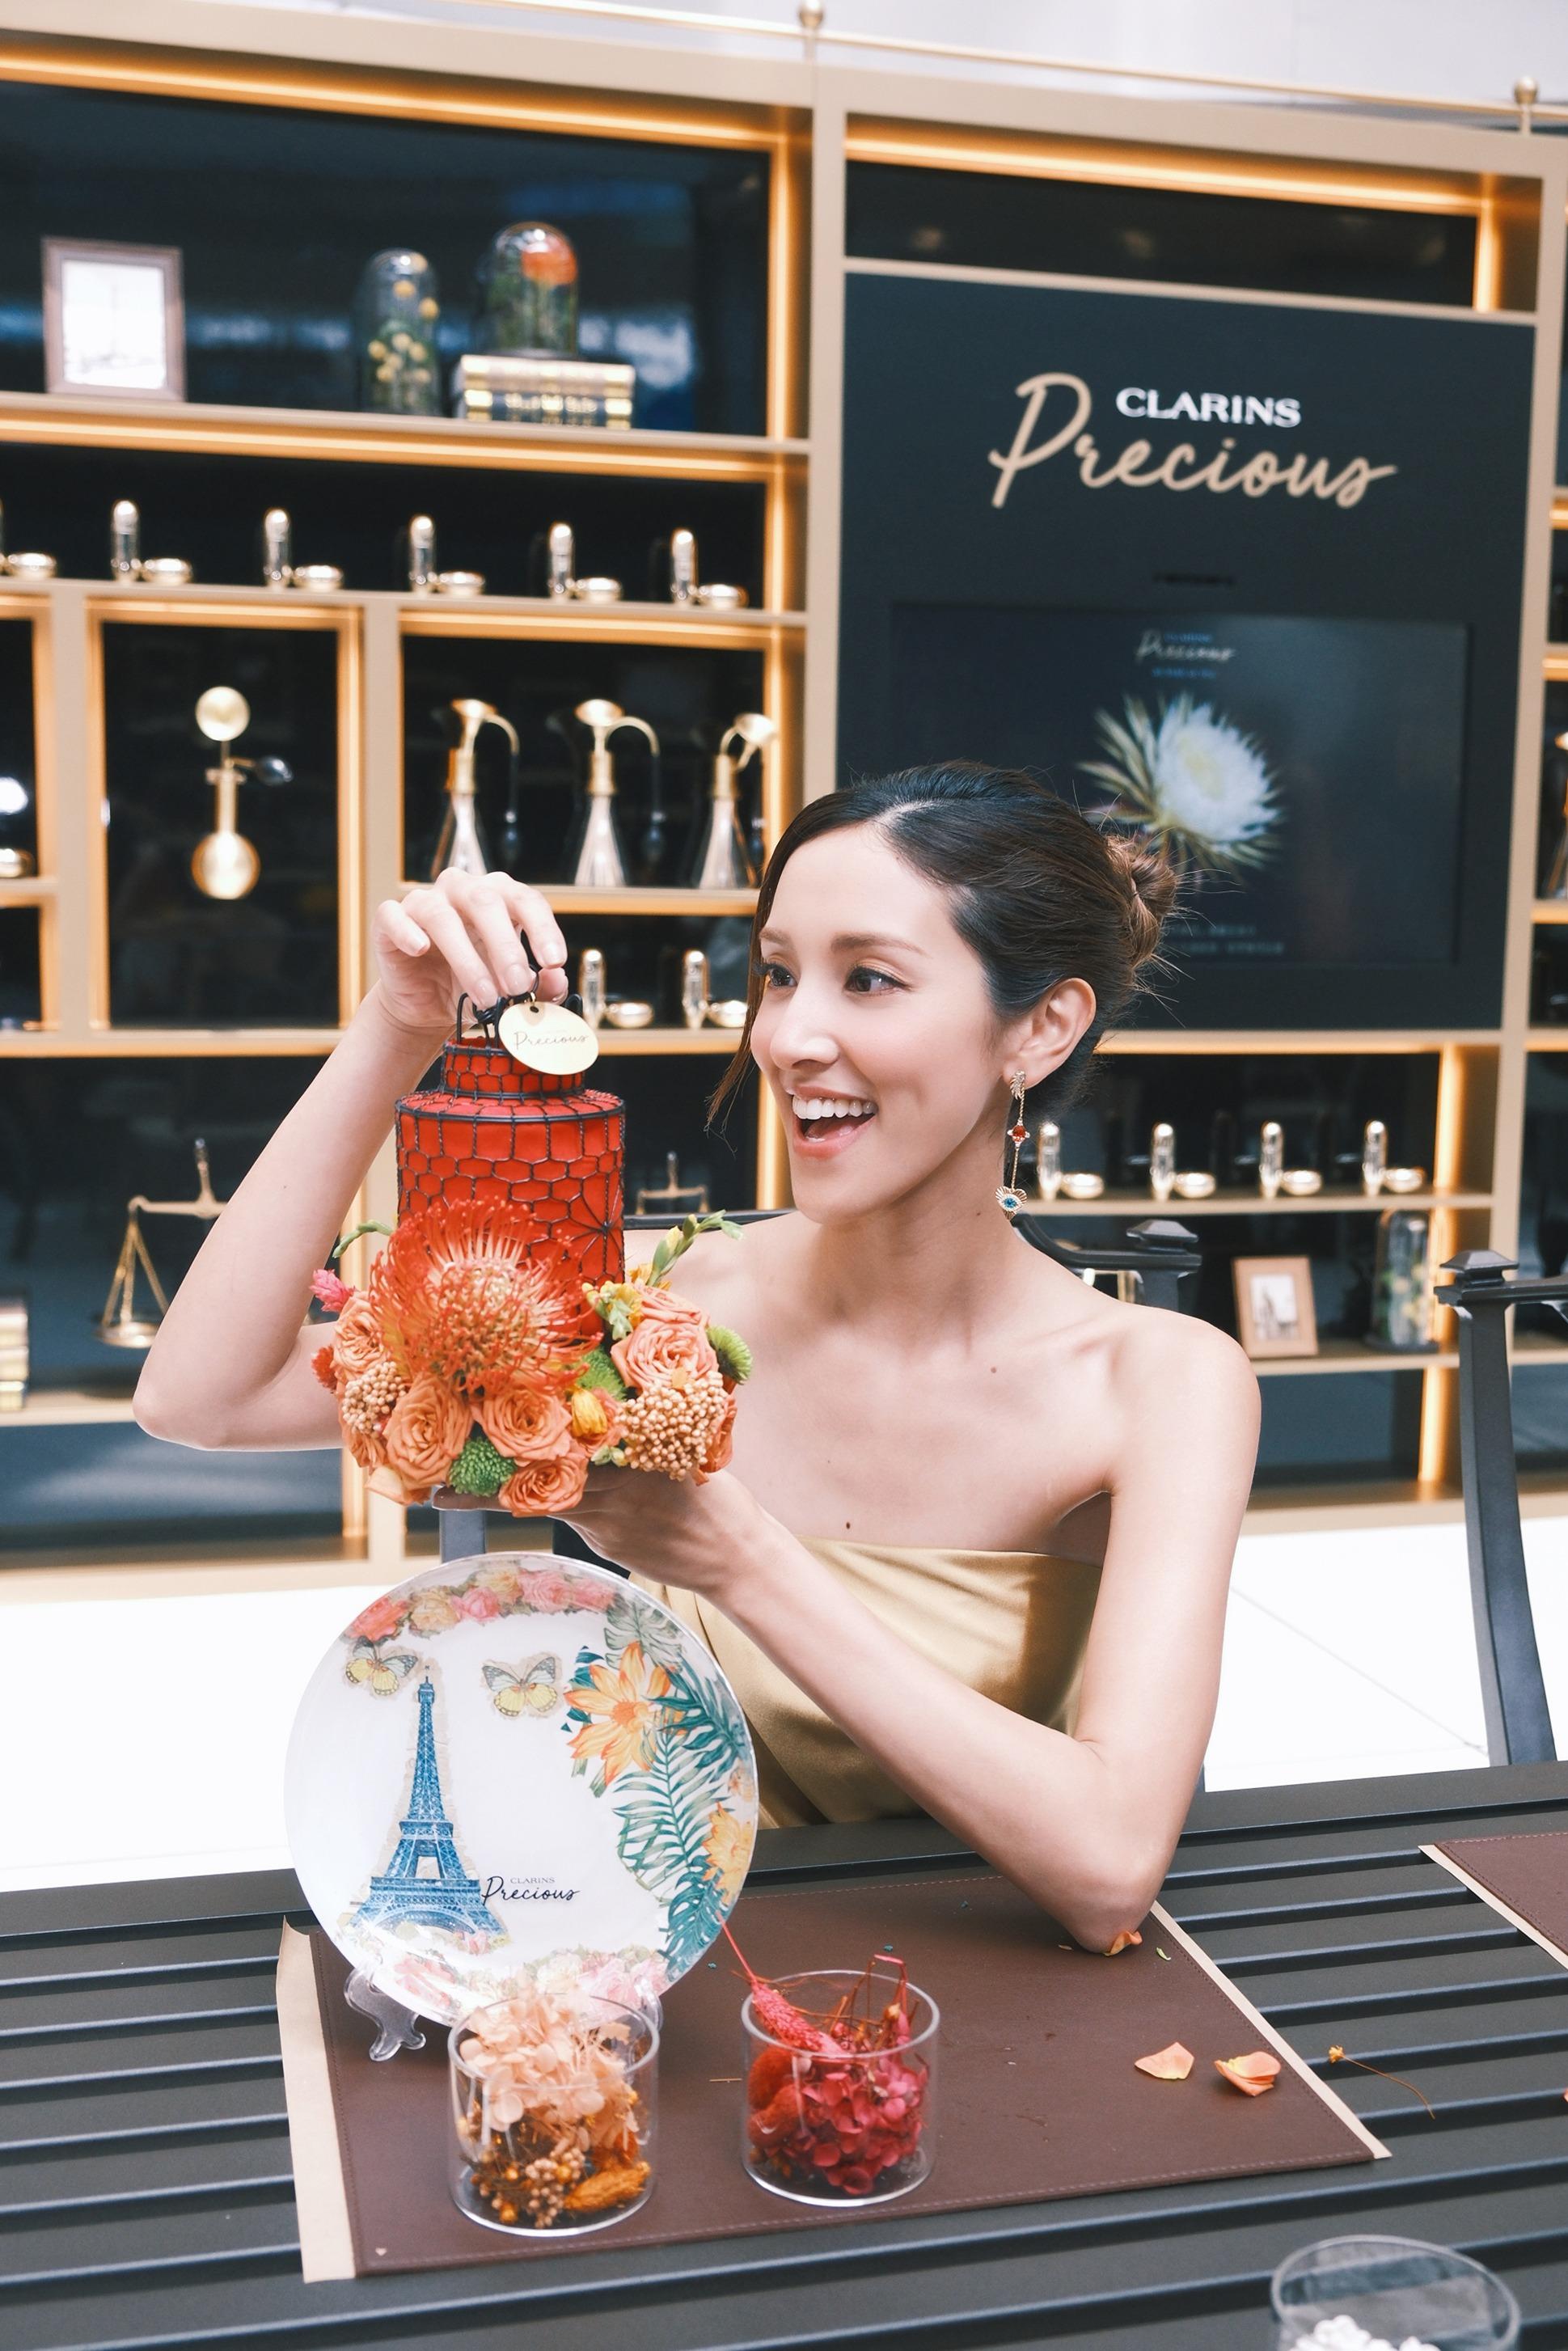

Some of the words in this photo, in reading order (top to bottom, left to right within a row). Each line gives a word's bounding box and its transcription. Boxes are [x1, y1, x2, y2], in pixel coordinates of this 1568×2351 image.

[1115, 387, 1302, 429] CLARINS
[987, 371, 1399, 510] Precious
[514, 1030, 589, 1051] Precious
[480, 1875, 581, 1907] Precious
[509, 1876, 556, 1884] CLARINS
